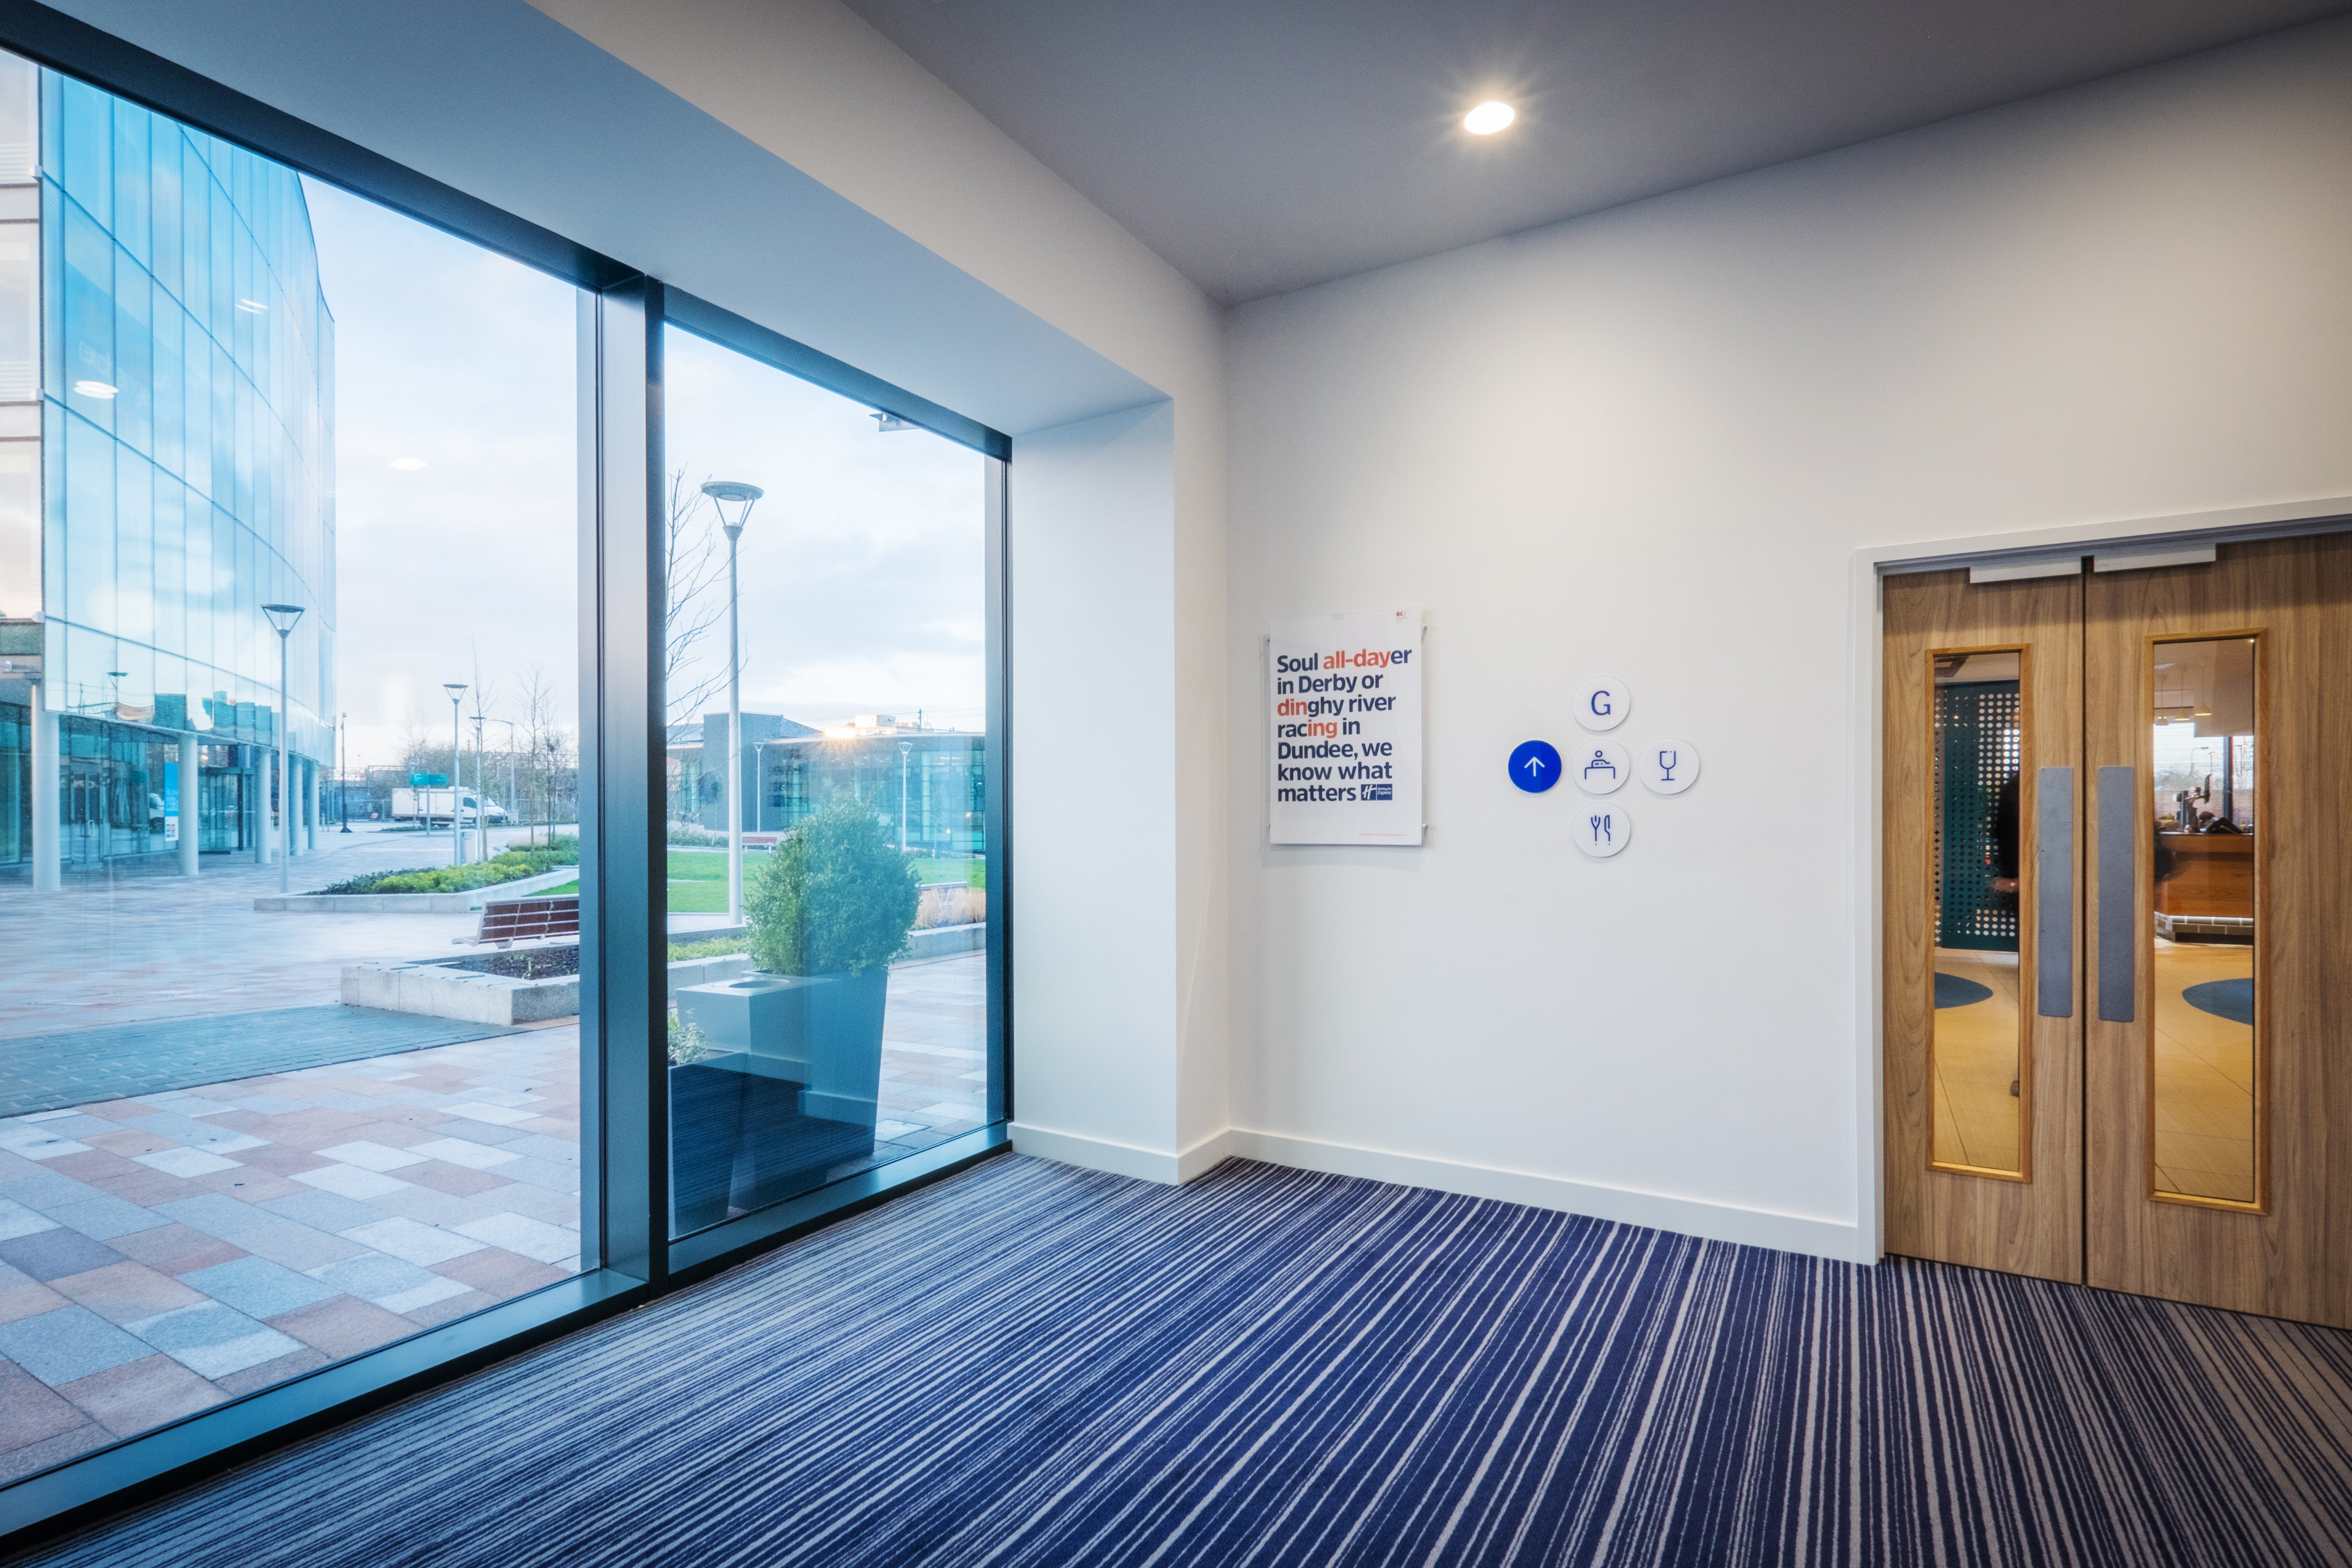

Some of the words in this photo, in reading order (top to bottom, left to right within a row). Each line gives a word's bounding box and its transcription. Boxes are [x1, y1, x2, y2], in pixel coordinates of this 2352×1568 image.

[1277, 652, 1318, 673] Soul
[1323, 649, 1412, 670] all-dayer
[1278, 677, 1294, 695] in
[1299, 673, 1357, 693] Derby
[1361, 674, 1383, 689] or
[1277, 696, 1344, 718] dinghy
[1348, 694, 1396, 713] river
[1591, 690, 1611, 716] G
[1278, 719, 1337, 739] racing
[1343, 717, 1360, 735] in
[1278, 740, 1358, 760] Dundee,
[1361, 742, 1392, 757] we
[1278, 763, 1332, 781] know
[1338, 761, 1392, 780] what
[1278, 785, 1357, 802] matters
